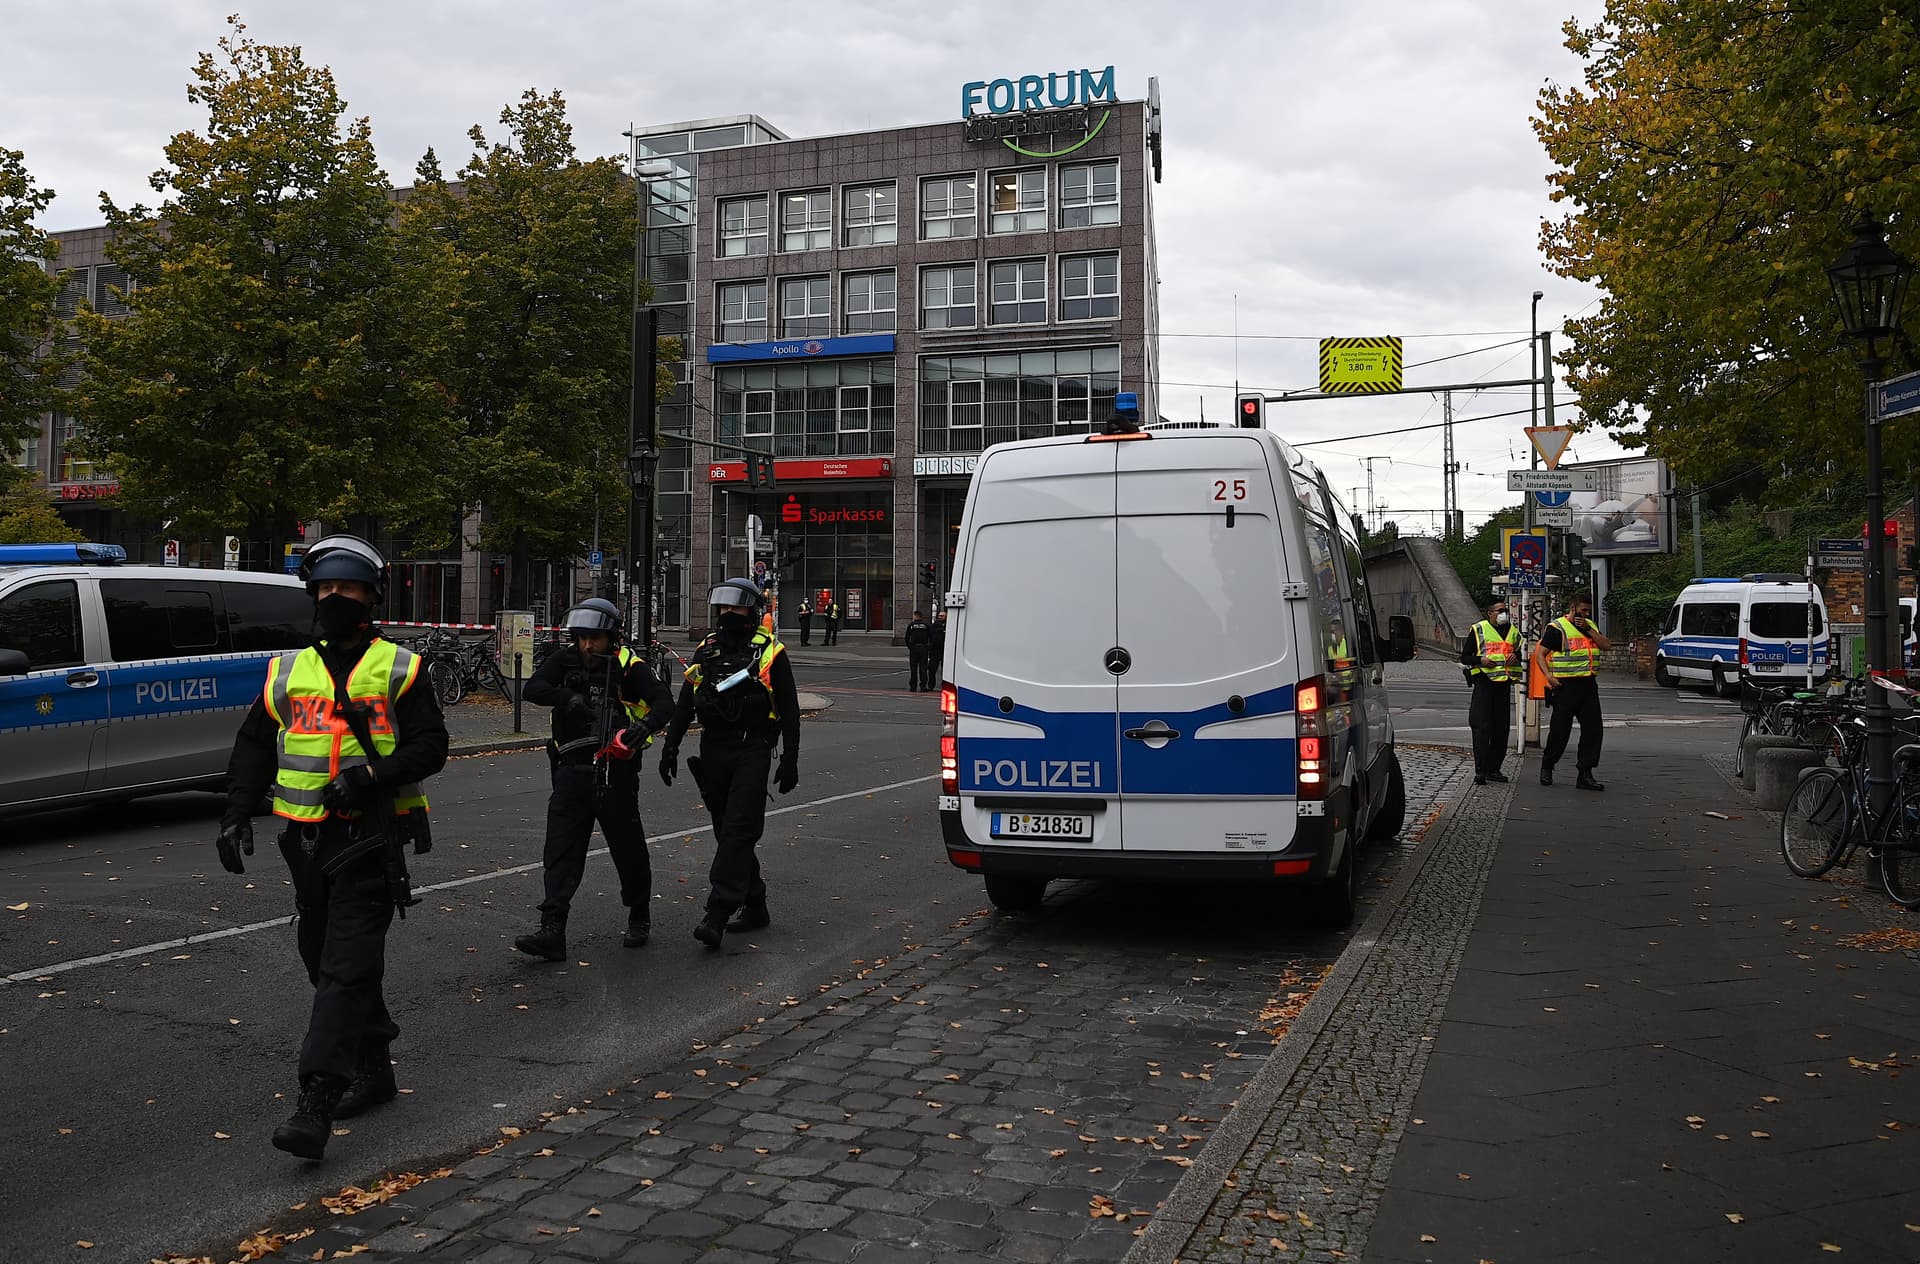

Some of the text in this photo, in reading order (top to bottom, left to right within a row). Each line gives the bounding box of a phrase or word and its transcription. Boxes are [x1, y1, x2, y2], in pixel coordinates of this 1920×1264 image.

[962, 65, 1114, 118] FORUM
[963, 110, 1088, 142] KÖPENICK
[772, 345, 799, 355] Apollo
[1349, 363, 1364, 371] 3,80
[1526, 473, 1568, 481] Friedrichshagen
[62, 484, 121, 500] ROSSMA
[1549, 482, 1572, 490] Köpenick
[809, 507, 885, 524] Sparkasse
[592, 553, 599, 563] P
[136, 677, 218, 704] POLIZEI
[974, 760, 1101, 787] POLIZEI
[1009, 816, 1020, 832] B
[1031, 817, 1083, 834] 31830
